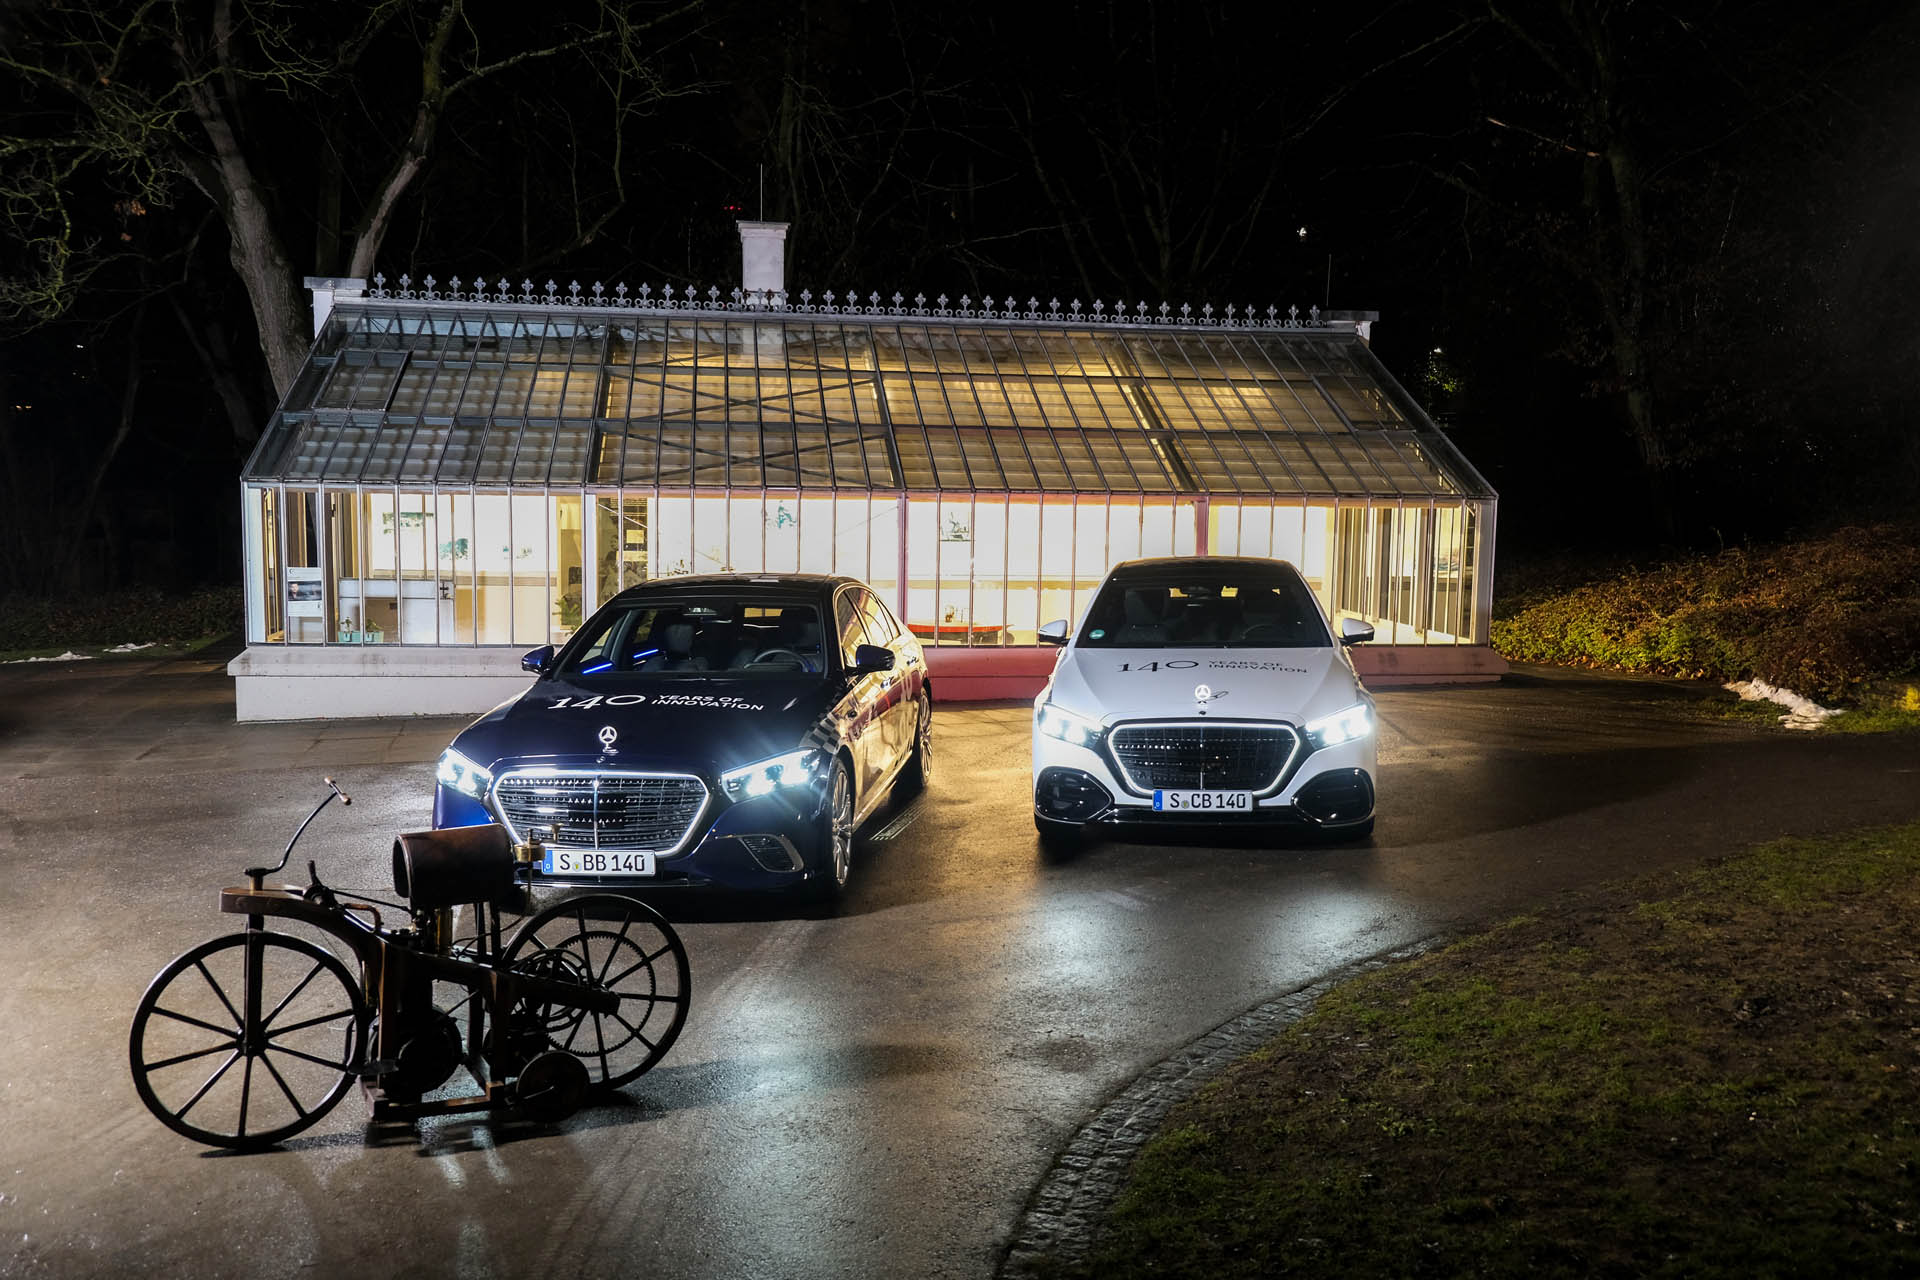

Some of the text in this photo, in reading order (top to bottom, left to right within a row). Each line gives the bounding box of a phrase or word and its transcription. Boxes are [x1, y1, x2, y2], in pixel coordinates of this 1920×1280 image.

[1117, 661, 1199, 672] 140
[1208, 664, 1307, 673] INNOVATION
[548, 695, 646, 709] 140
[651, 699, 765, 711] INNOVATION
[1170, 793, 1180, 808] S
[1191, 793, 1212, 808] CB
[1215, 793, 1246, 808] 140
[560, 854, 570, 870] S
[583, 854, 607, 871] BB
[611, 854, 645, 871] 140
